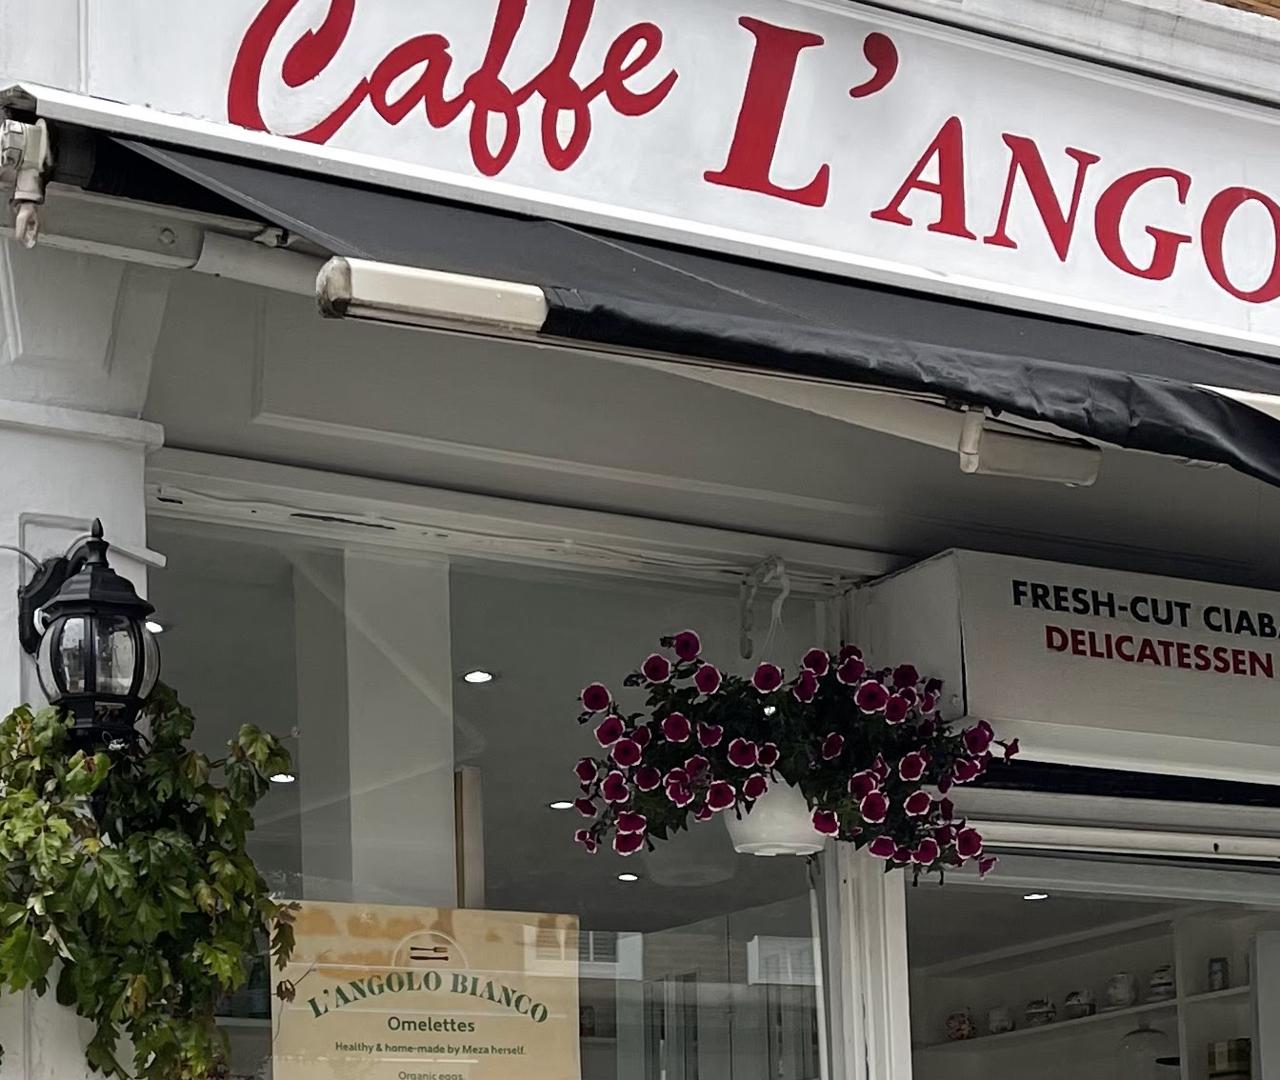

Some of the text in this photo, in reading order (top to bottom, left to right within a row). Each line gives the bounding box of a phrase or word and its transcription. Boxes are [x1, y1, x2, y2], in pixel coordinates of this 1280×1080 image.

[227, 0, 679, 177] Caffe
[1011, 579, 1191, 628] FRESH-CUT
[1045, 625, 1274, 679] DELICATESSEN
[308, 971, 548, 1023] L'ANGOLO BIANCO
[336, 1042, 373, 1054] Healthy
[376, 1044, 383, 1052] &
[385, 1043, 445, 1054] home-made
[447, 1044, 460, 1056] by
[462, 1045, 489, 1055] Meza
[387, 1016, 475, 1033] Omelettes
